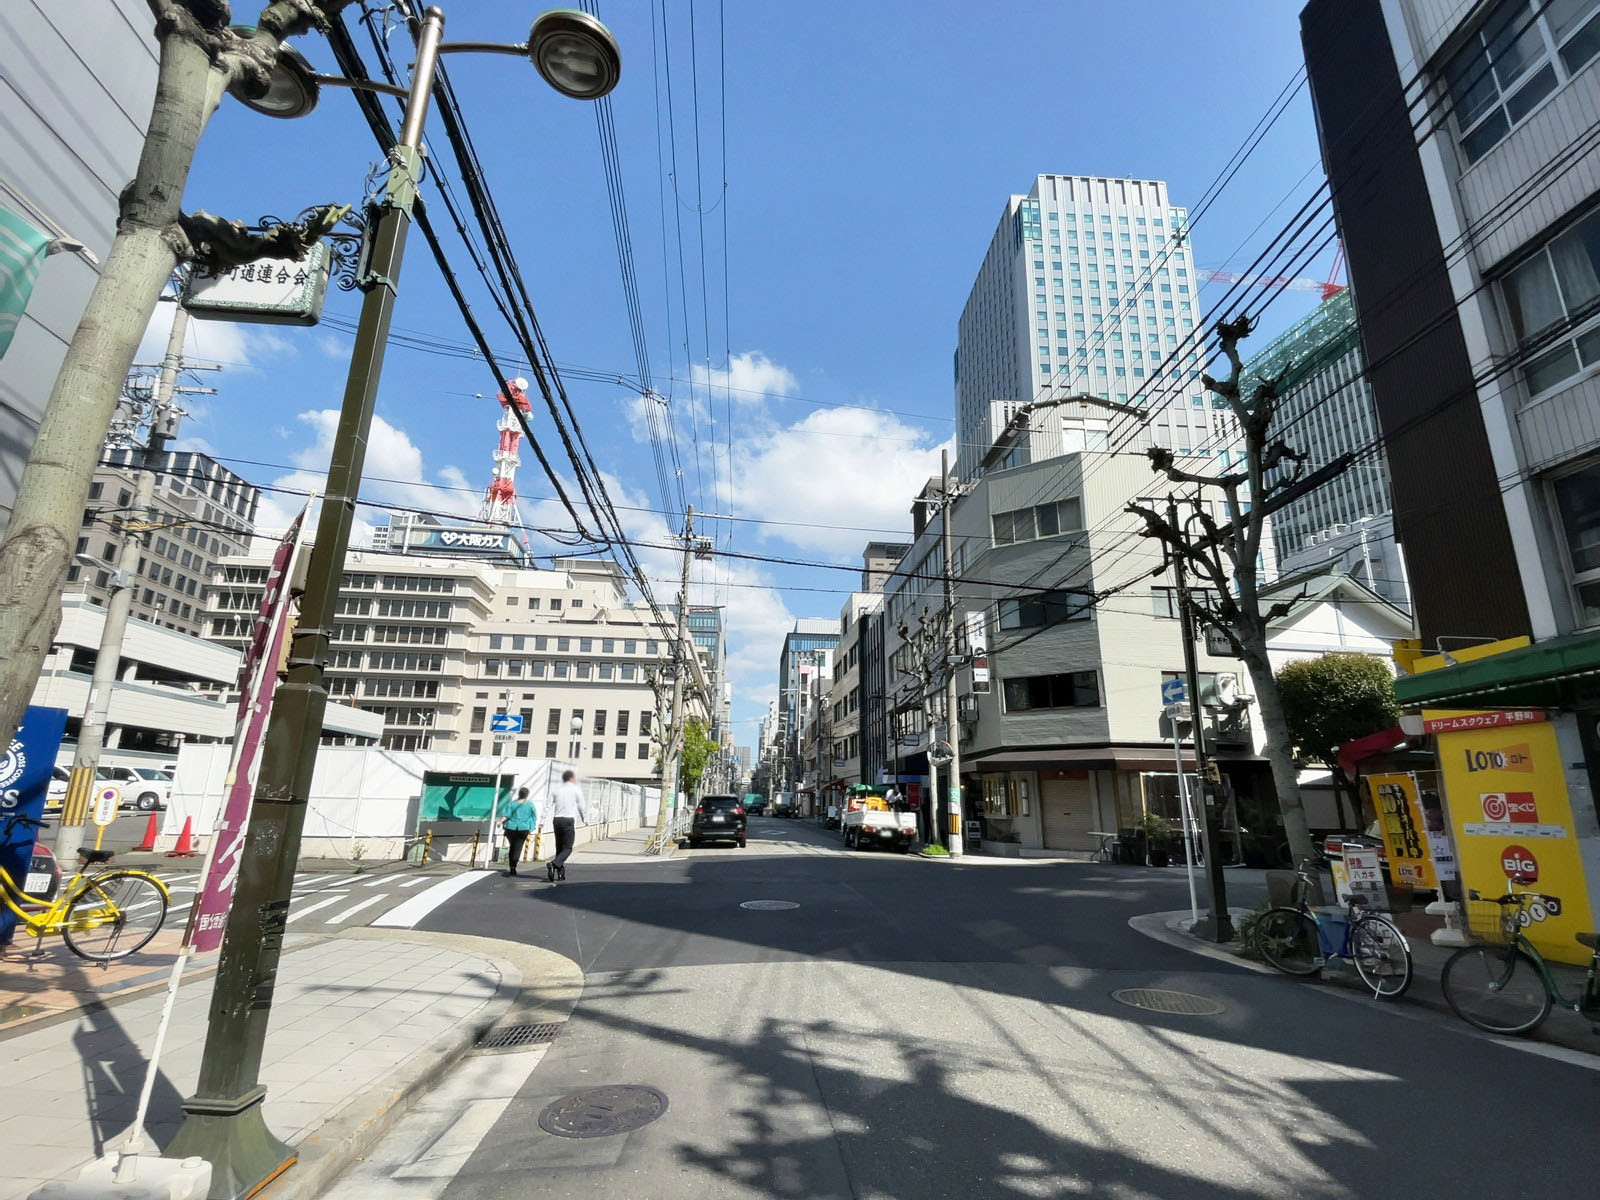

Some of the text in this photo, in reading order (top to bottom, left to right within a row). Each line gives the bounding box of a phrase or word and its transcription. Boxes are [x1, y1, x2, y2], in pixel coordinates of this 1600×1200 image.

[192, 263, 308, 286] 平町通連合会
[456, 533, 504, 548] 大阪ガス
[1431, 714, 1499, 730] ドリームスクウェア
[16, 752, 25, 768] BOSS
[1465, 749, 1528, 772] LOTO ロト
[1353, 870, 1375, 879] ハガキ
